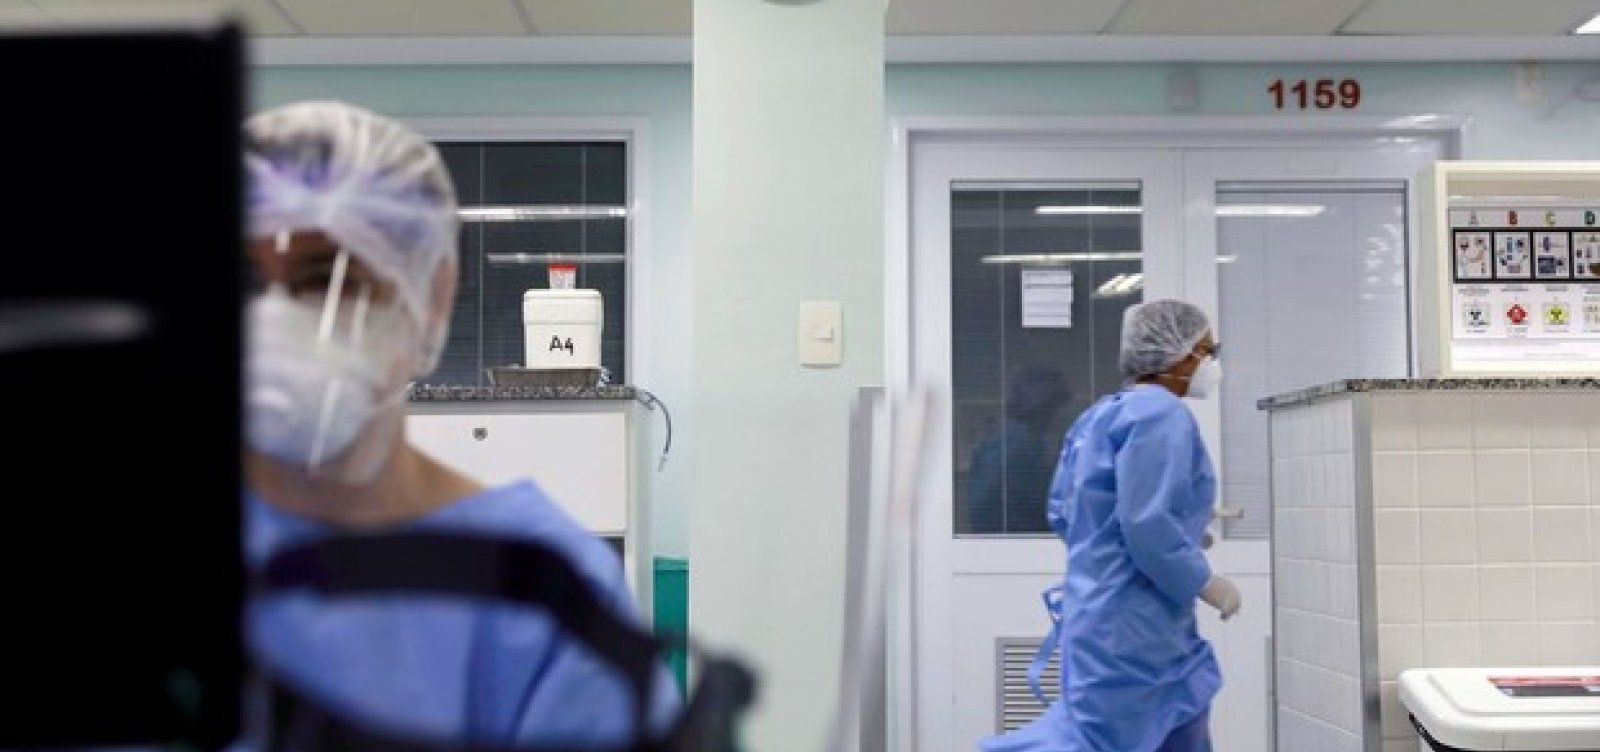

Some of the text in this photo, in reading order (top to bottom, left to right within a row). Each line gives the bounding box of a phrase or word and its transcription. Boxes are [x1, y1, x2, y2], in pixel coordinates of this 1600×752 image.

[1267, 79, 1361, 109] 1159
[1507, 211, 1518, 225] B
[1545, 211, 1556, 225] C
[1584, 211, 1596, 225] D
[549, 335, 574, 357] A4
